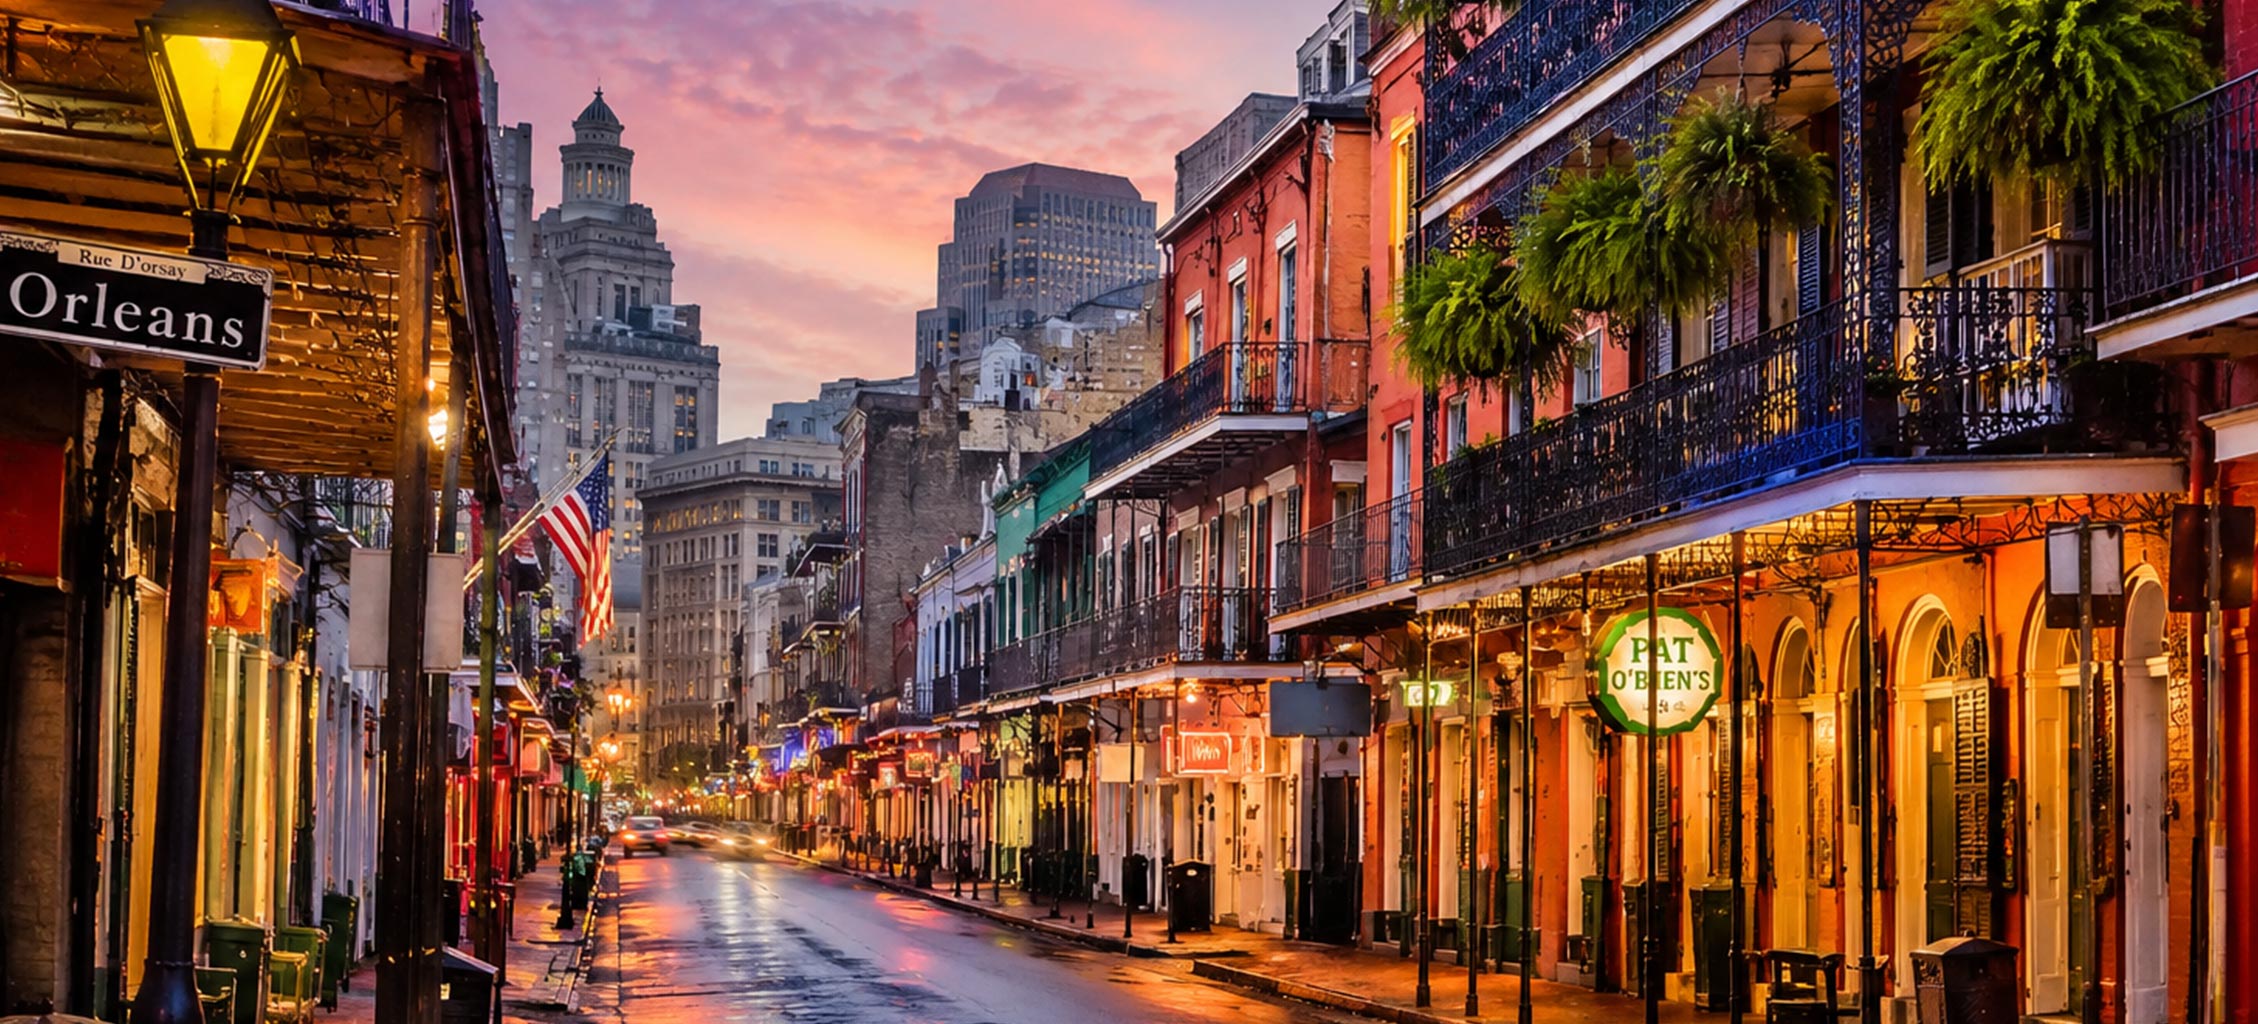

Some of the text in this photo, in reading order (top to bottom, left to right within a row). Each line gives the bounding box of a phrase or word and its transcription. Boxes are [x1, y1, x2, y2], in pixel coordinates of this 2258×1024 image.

[79, 248, 187, 281] Rue D'orsay
[9, 271, 243, 348] Orleans
[1631, 637, 1694, 663] PAT
